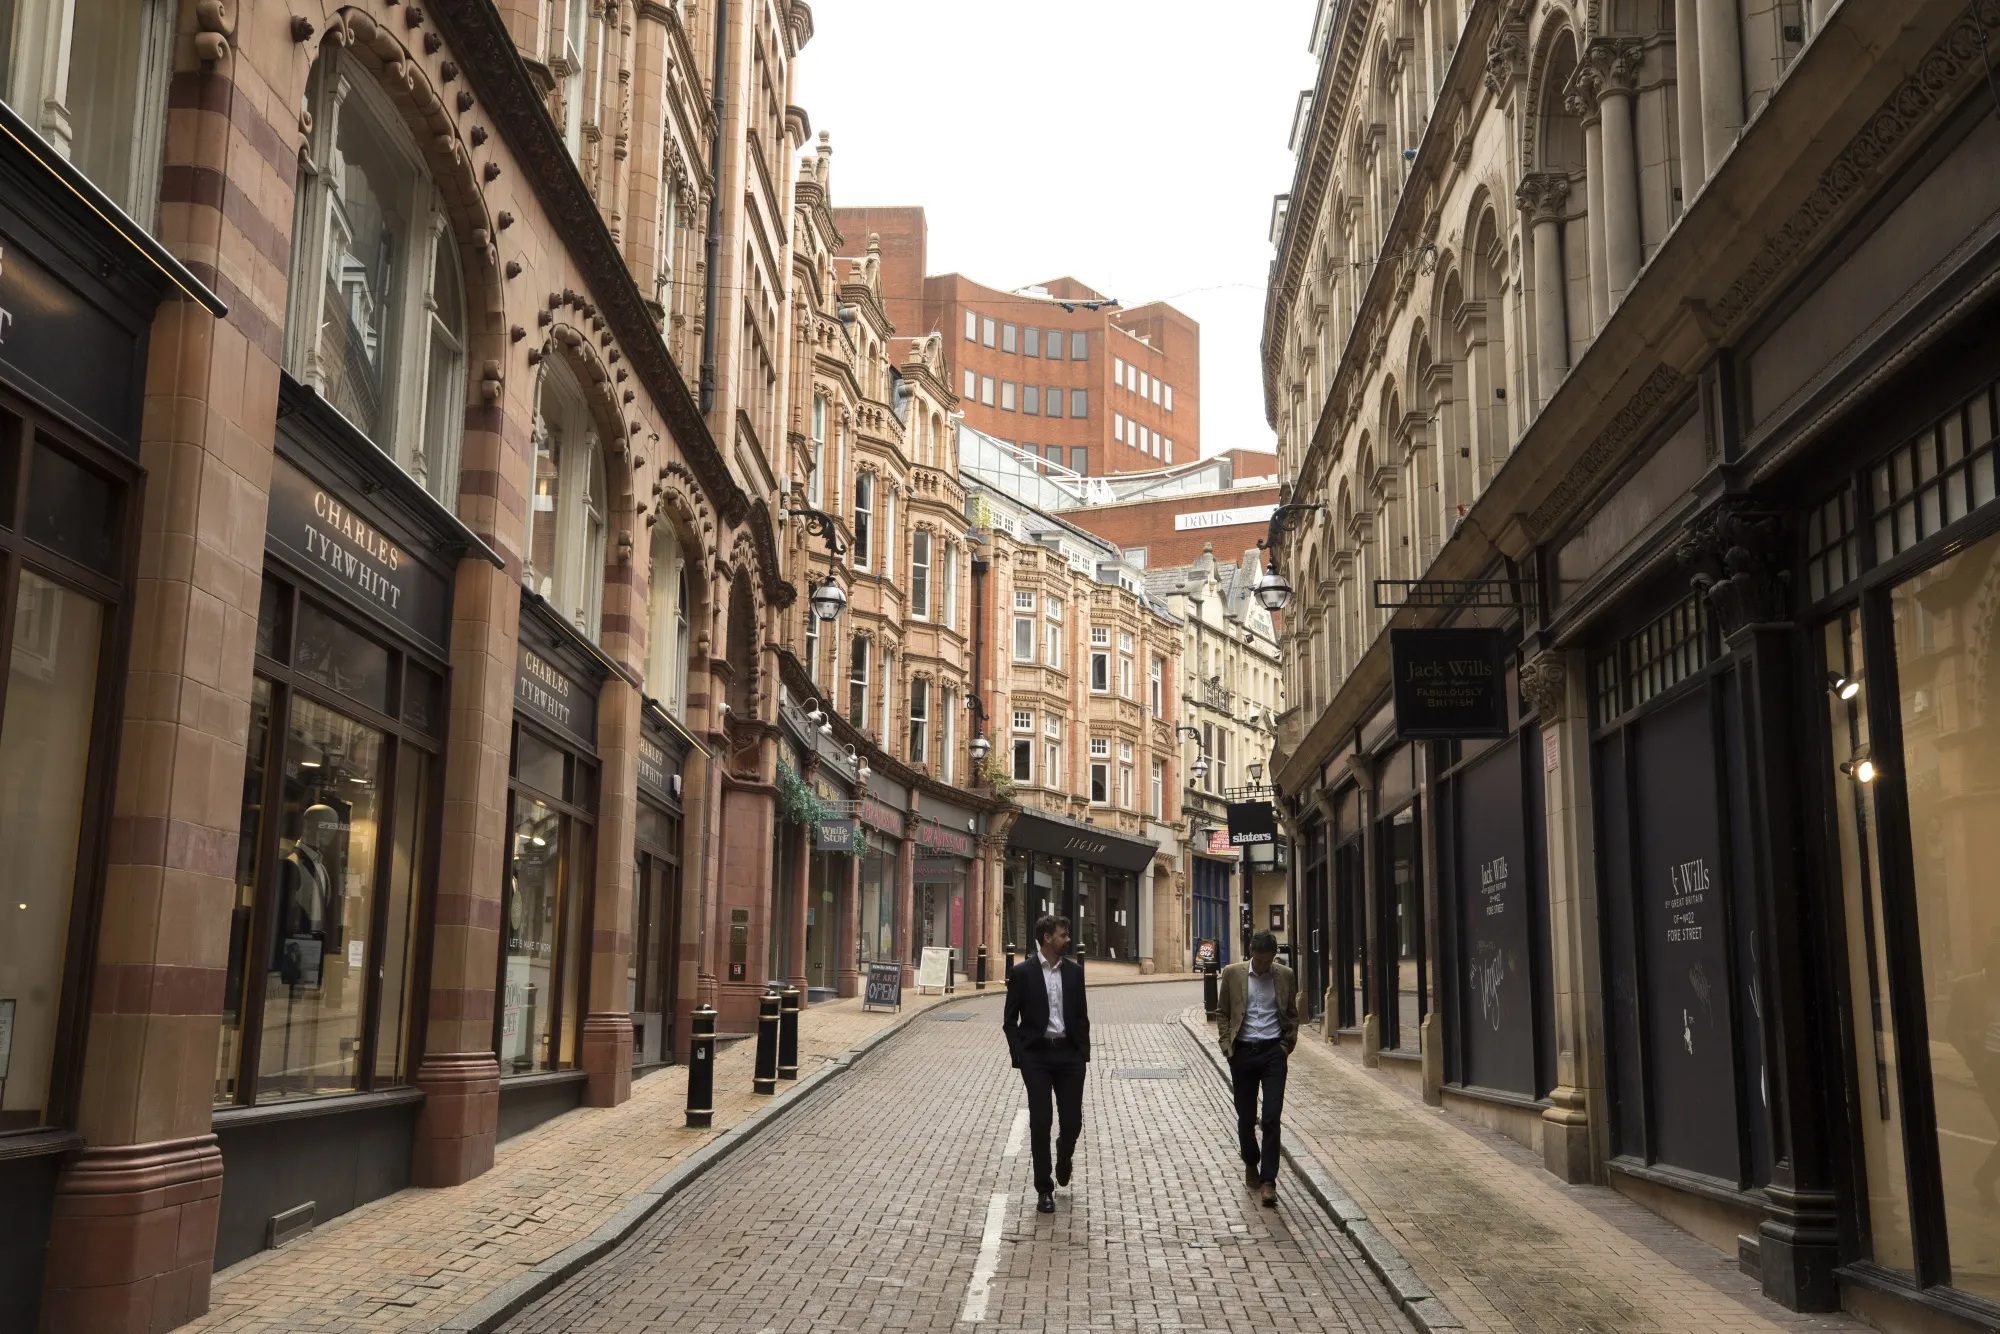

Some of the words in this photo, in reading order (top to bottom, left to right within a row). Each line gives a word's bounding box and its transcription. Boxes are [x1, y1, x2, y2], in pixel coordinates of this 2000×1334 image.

[315, 492, 399, 571] CHARLES
[304, 524, 401, 609] TYRWHITT
[525, 652, 569, 697] CHARLES
[1405, 661, 1443, 683] Jack
[1448, 660, 1492, 677] Wills
[521, 676, 570, 725] TYRWHITT
[1427, 698, 1474, 708] BRITISH
[640, 737, 663, 767] HARLES
[1064, 837, 1107, 853] JIGSAW
[1232, 831, 1272, 843] slaters
[1680, 858, 1710, 895] Wills
[1671, 897, 1685, 909] GREAT
[1685, 893, 1704, 906] BRITAIN
[1667, 929, 1681, 942] FORE
[1682, 926, 1703, 941] STREET
[870, 972, 881, 981] WE
[882, 974, 898, 982] ARE
[868, 982, 897, 1001] OPEN
